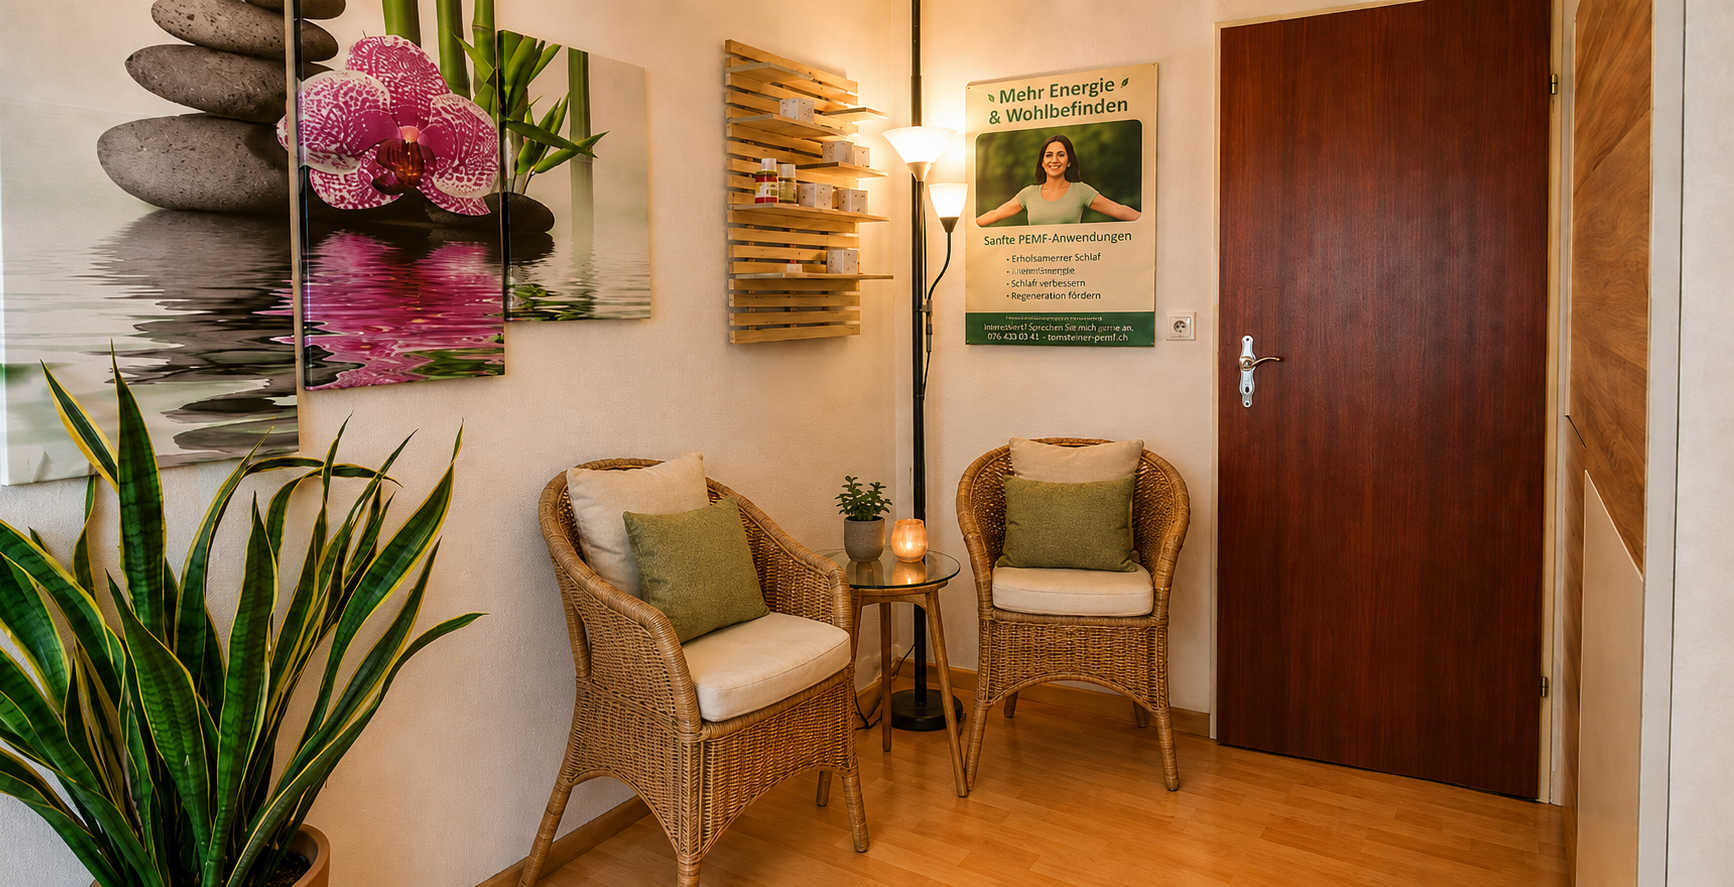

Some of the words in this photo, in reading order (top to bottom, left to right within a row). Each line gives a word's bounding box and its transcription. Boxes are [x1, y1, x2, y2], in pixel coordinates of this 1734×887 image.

[999, 85, 1045, 104] Mehr
[1050, 77, 1115, 98] Energie
[988, 110, 1001, 125] &
[1006, 98, 1128, 123] Wohlbefinden
[984, 235, 1016, 246] Sanfte
[1018, 231, 1132, 245] PEMF-Anwendungen
[1074, 252, 1102, 262] Schlaf
[1039, 279, 1086, 288] verbessern
[1011, 291, 1066, 302] Regeneration
[1078, 323, 1097, 332] mich
[987, 332, 1002, 341] 076
